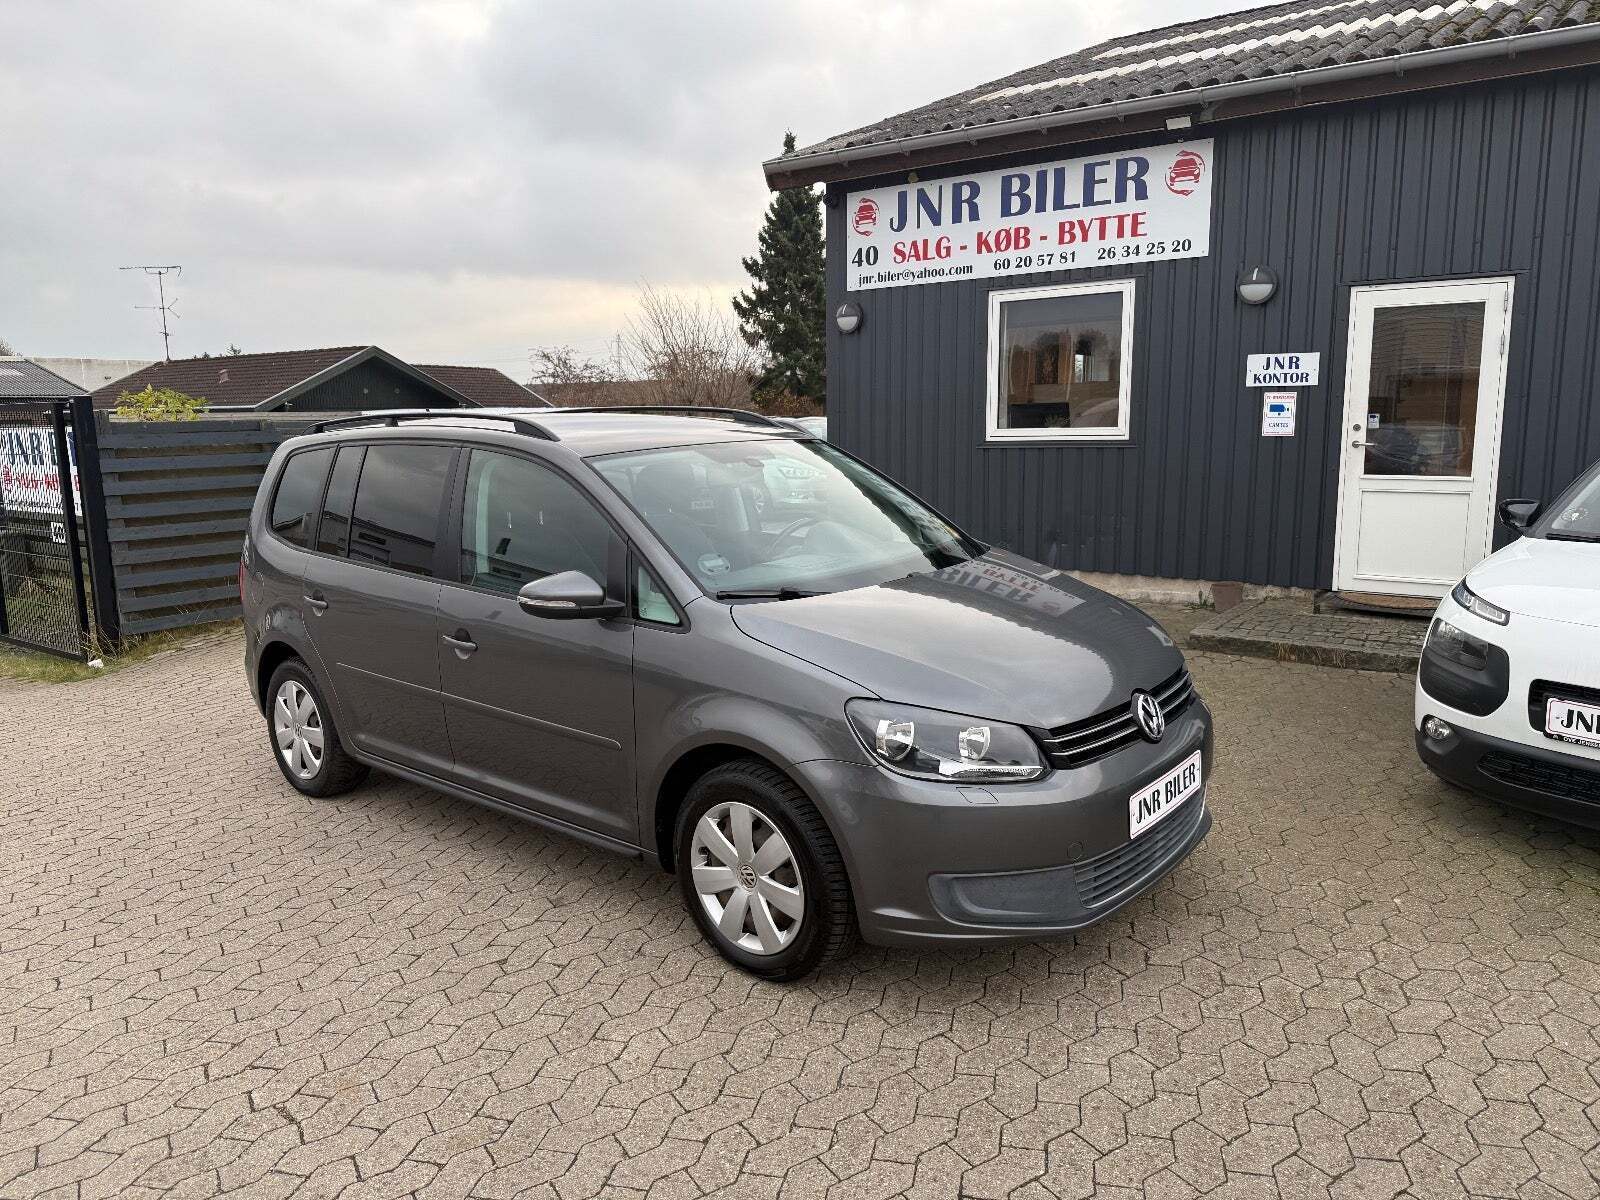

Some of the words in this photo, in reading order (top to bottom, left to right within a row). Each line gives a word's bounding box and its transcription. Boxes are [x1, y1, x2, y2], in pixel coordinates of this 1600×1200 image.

[889, 180, 981, 233] JNR
[1000, 156, 1150, 218] BILER
[852, 245, 879, 268] 40
[893, 235, 952, 264] SALG
[976, 226, 1031, 255] KØB
[1058, 211, 1148, 245] BYTTE
[1097, 246, 1117, 261] 26
[1121, 244, 1141, 258] 34
[1146, 241, 1166, 256] 25
[1171, 238, 1193, 253] 20
[993, 258, 1011, 271] 60
[1015, 255, 1033, 269] 20
[1036, 253, 1055, 267] 57
[1059, 250, 1076, 264] 81
[858, 265, 973, 287] jnr.biler@yahoo.com
[1262, 356, 1300, 370] JNR
[1253, 372, 1310, 384] KONTOR
[1136, 788, 1161, 824] JNR
[1164, 762, 1196, 805] BILER
